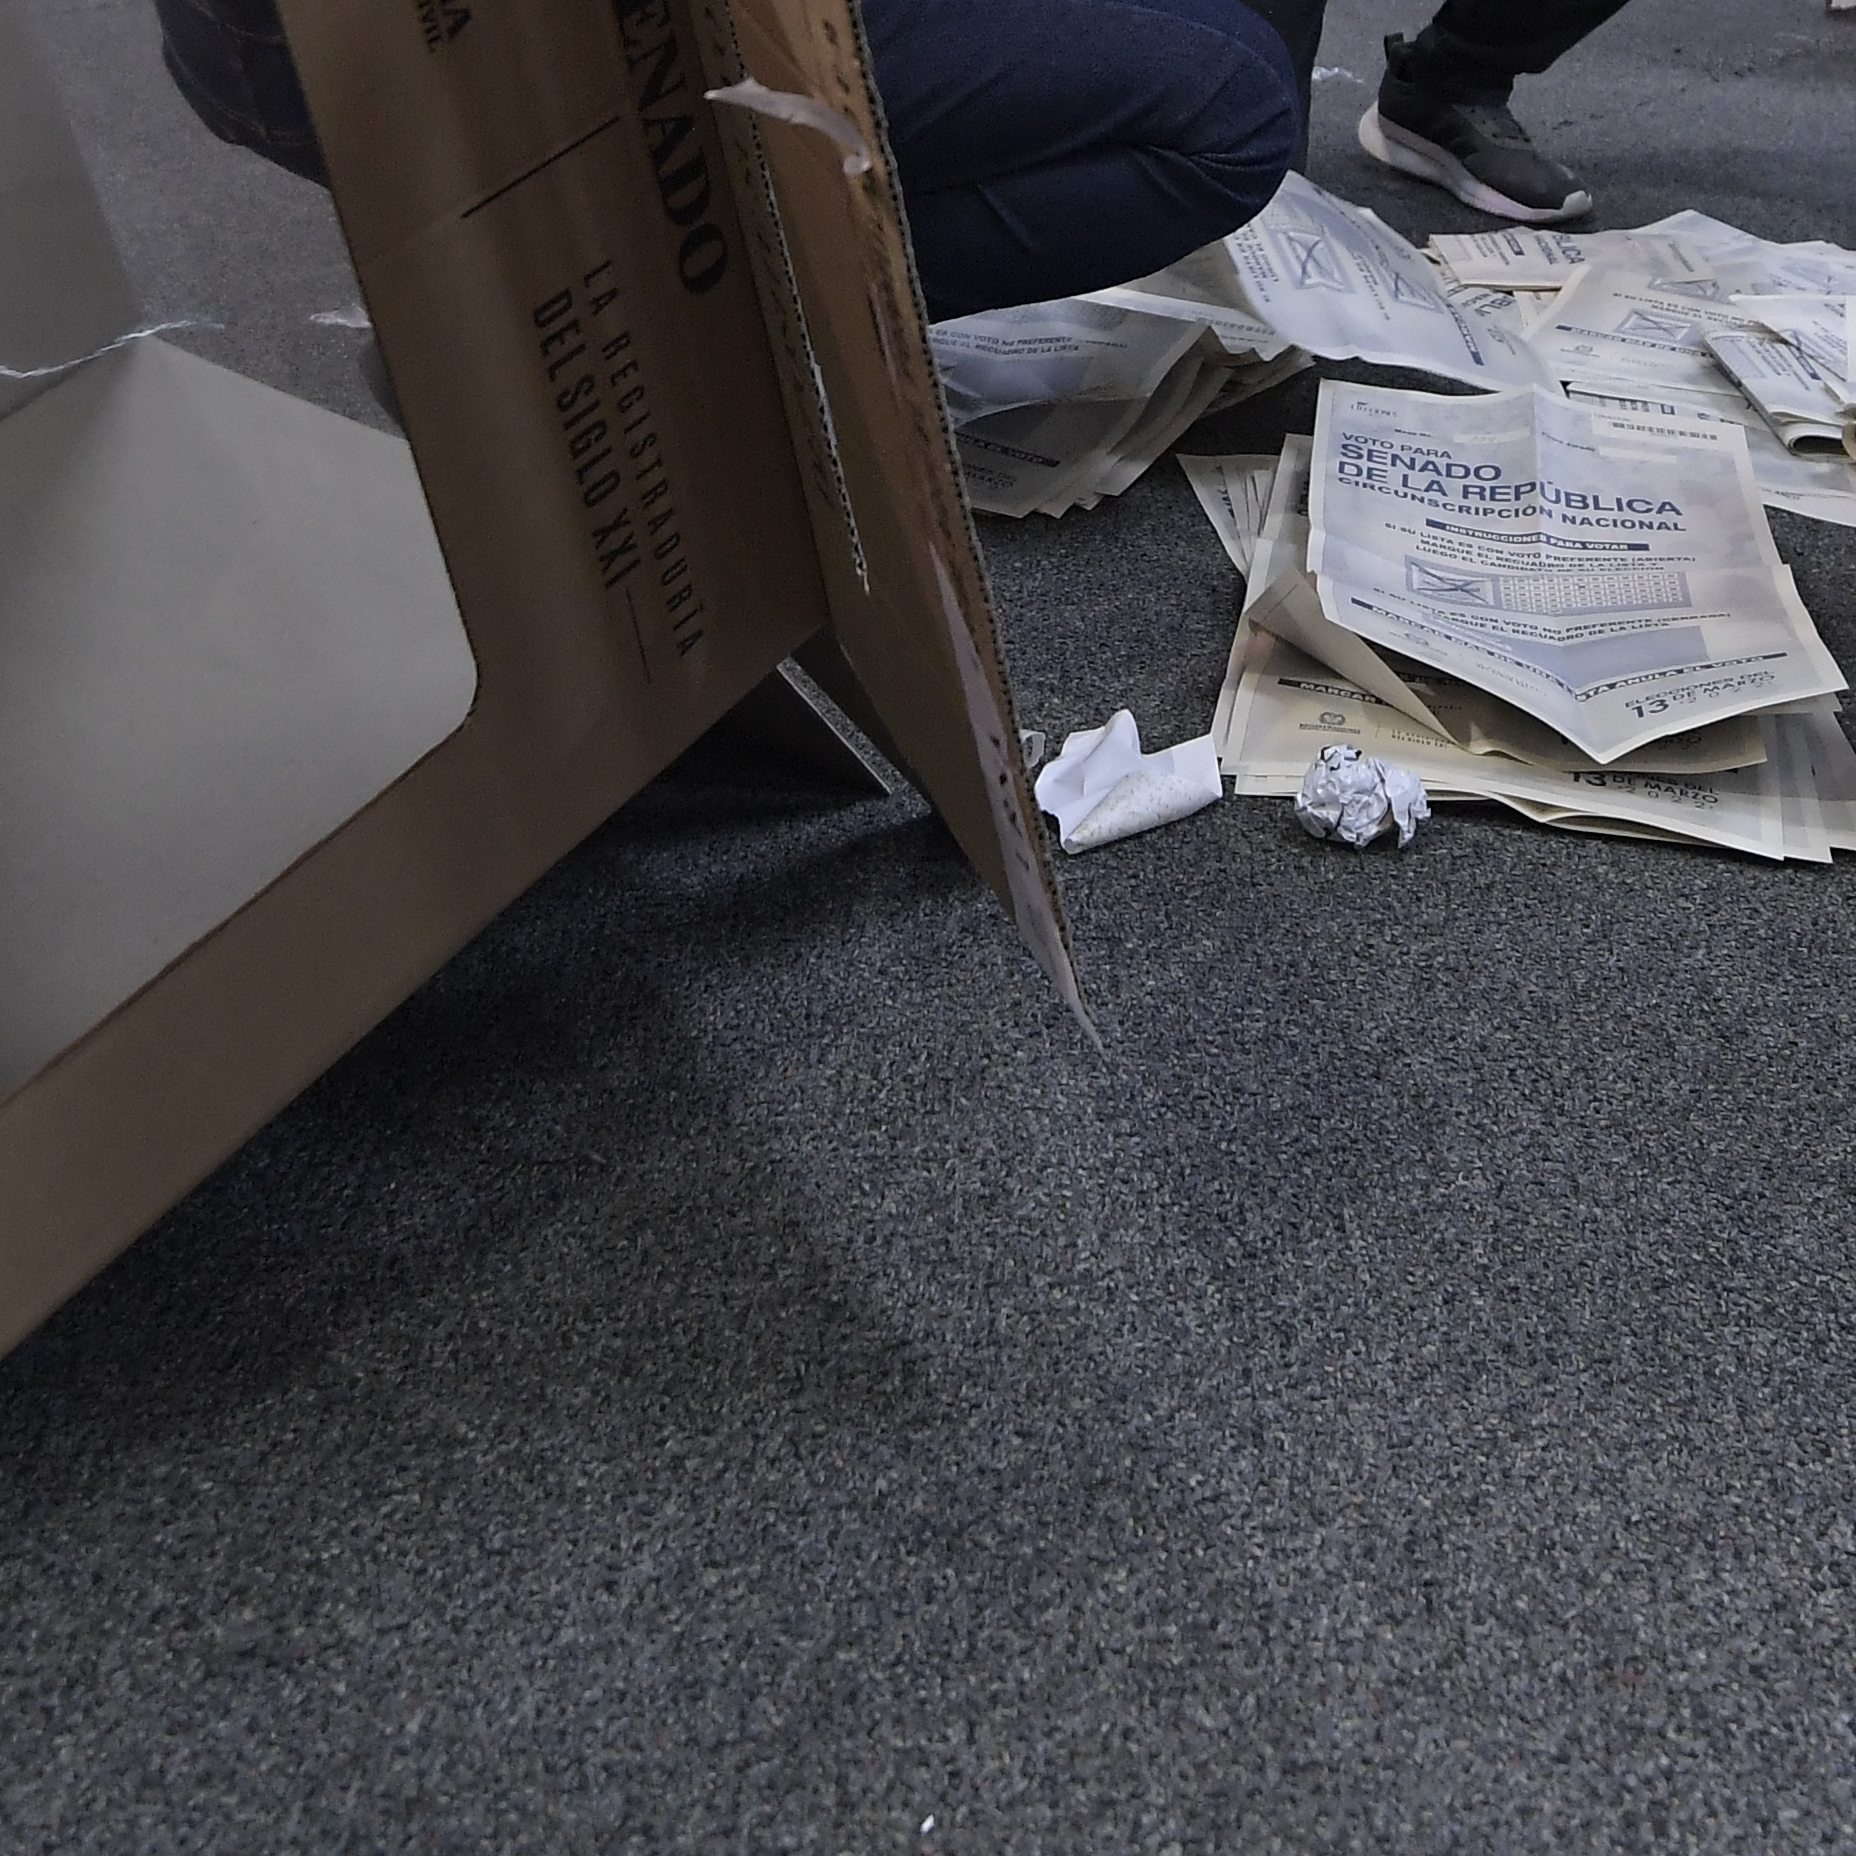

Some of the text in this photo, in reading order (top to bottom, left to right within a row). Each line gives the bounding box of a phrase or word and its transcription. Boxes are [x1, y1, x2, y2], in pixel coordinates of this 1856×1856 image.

[533, 287, 643, 590] DEL SIGLO XXI
[1342, 431, 1453, 460] VOTO PARA
[584, 258, 705, 658] LA REGISTRADURÍA
[1340, 443, 1502, 482] SENADO
[1338, 460, 1683, 517] DE LA REPÚBLICA
[1338, 476, 1687, 532] CIRCUNSCRIPCIÓN NACIONAL
[1420, 531, 1454, 545] LISTA
[1458, 540, 1474, 549] ES
[1477, 545, 1504, 555] CON
[1507, 550, 1542, 560] VOTO
[1420, 538, 1474, 556] MARQUE
[1445, 523, 1629, 550] INSTRUCCIONES PARA VOTAR
[1415, 544, 1458, 560] LUEGO
[1470, 614, 1499, 624] CON
[1502, 619, 1539, 631] VOTO
[1300, 682, 1377, 703] MARCAR
[1614, 669, 1679, 689] ANULA
[1624, 674, 1736, 709] ELECCIONES
[1631, 697, 1670, 719] 13
[1572, 772, 1607, 787] 13
[1644, 780, 1719, 804] MARZO
